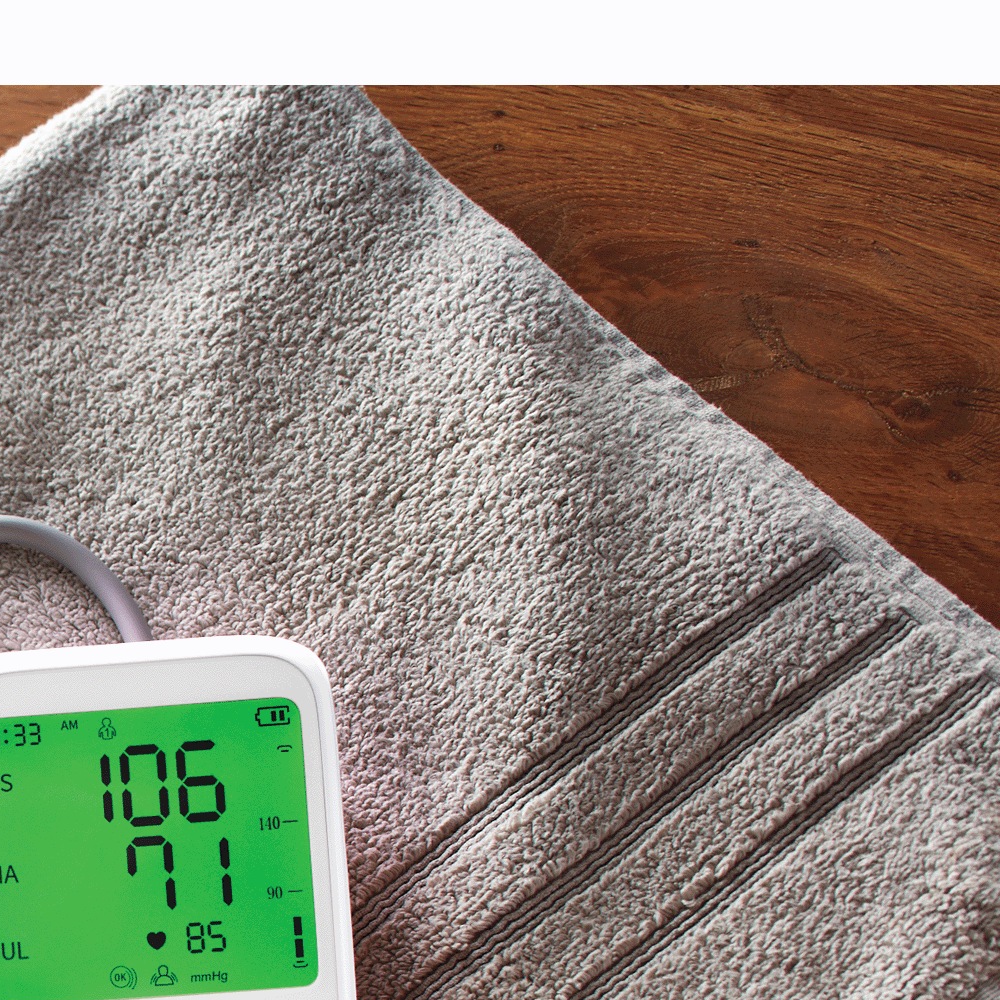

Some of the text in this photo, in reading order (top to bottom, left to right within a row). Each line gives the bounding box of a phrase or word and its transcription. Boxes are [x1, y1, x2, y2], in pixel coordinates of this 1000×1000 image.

[60, 719, 78, 731] AM
[100, 739, 226, 827] 106
[258, 816, 280, 831] 140
[126, 835, 233, 910] 71
[267, 886, 283, 900] 90
[186, 920, 227, 954] 85
[114, 972, 127, 983] OK
[190, 970, 228, 983] mmHg
